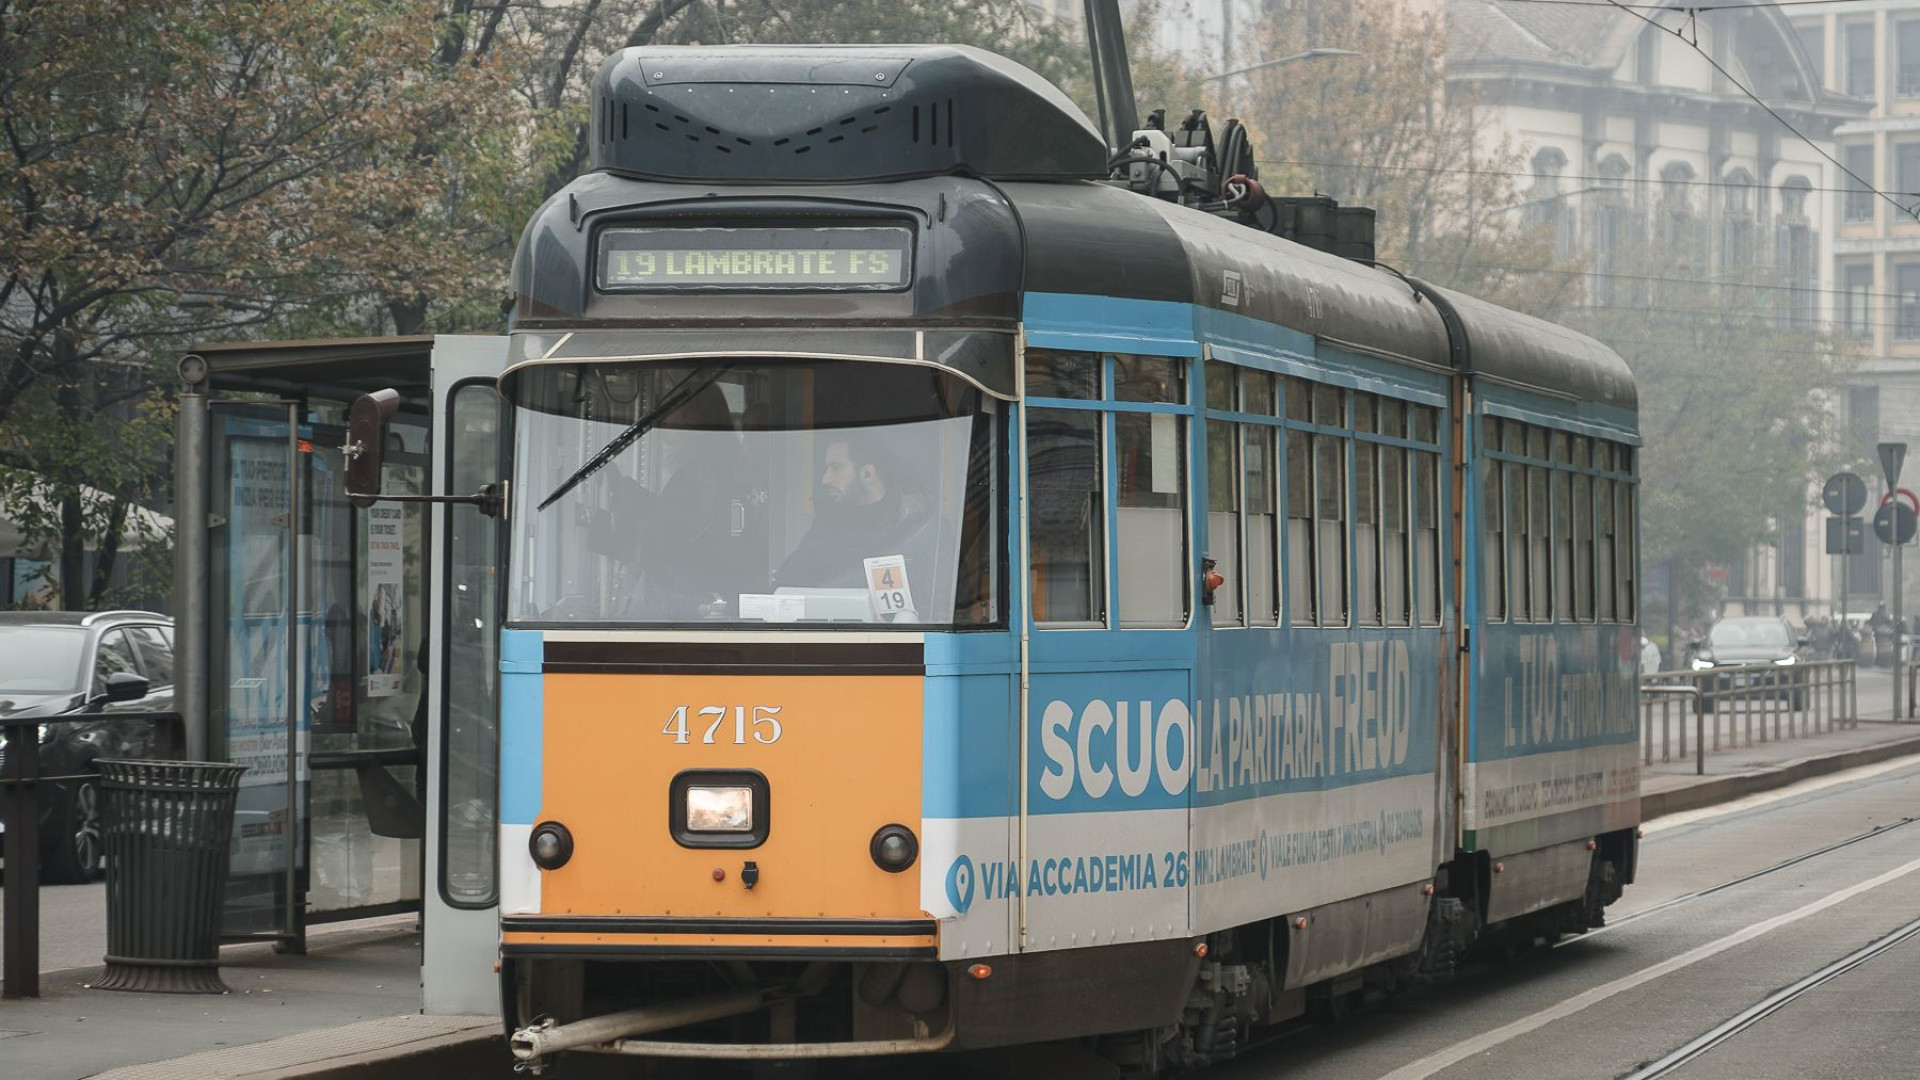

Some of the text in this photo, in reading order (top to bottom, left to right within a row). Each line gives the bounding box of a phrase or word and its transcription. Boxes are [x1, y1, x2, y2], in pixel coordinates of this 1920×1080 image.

[616, 250, 889, 275] 19 LAMBRATE FS
[882, 568, 895, 590] 4
[880, 591, 905, 610] 19
[1519, 632, 1558, 745] TUO
[661, 705, 783, 744] 4715
[1039, 639, 1410, 801] SCUOLA PARITARIA FREUD
[980, 862, 1020, 900] VIA
[1027, 853, 1157, 897] ACCADEMIA
[1163, 851, 1188, 888] 26
[1216, 839, 1256, 883] LAMBRATE
[1270, 834, 1291, 869] VIALE
